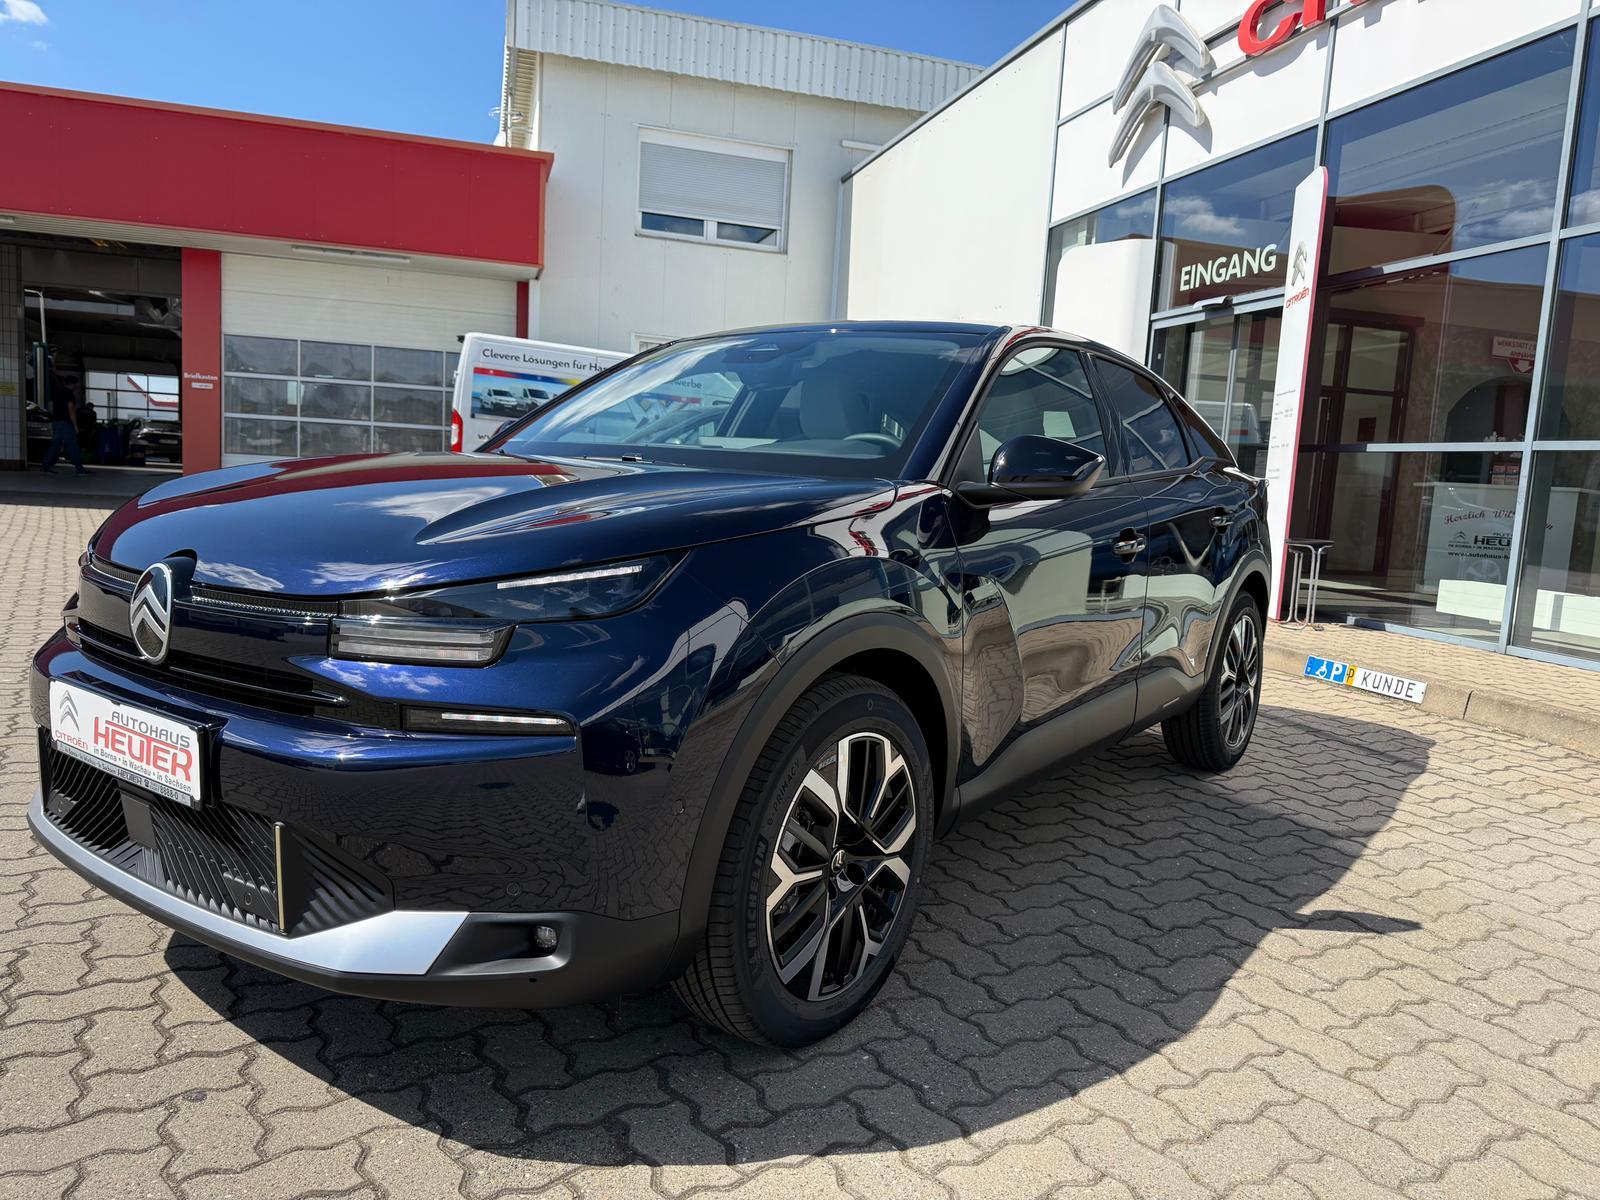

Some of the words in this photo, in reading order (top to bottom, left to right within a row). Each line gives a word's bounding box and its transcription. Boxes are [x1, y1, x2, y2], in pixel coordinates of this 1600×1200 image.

[1180, 244, 1277, 291] EINGANG
[482, 348, 520, 361] Clevere
[523, 354, 570, 368] Lösungen
[573, 360, 586, 370] für
[1361, 671, 1416, 698] KUNDE
[94, 716, 192, 782] HEUTER
[112, 711, 190, 748] AUTOHAUS
[100, 748, 117, 762] Borna
[129, 760, 151, 776] Wachau
[164, 775, 191, 792] Sachsen
[748, 839, 768, 947] MICHELIN
